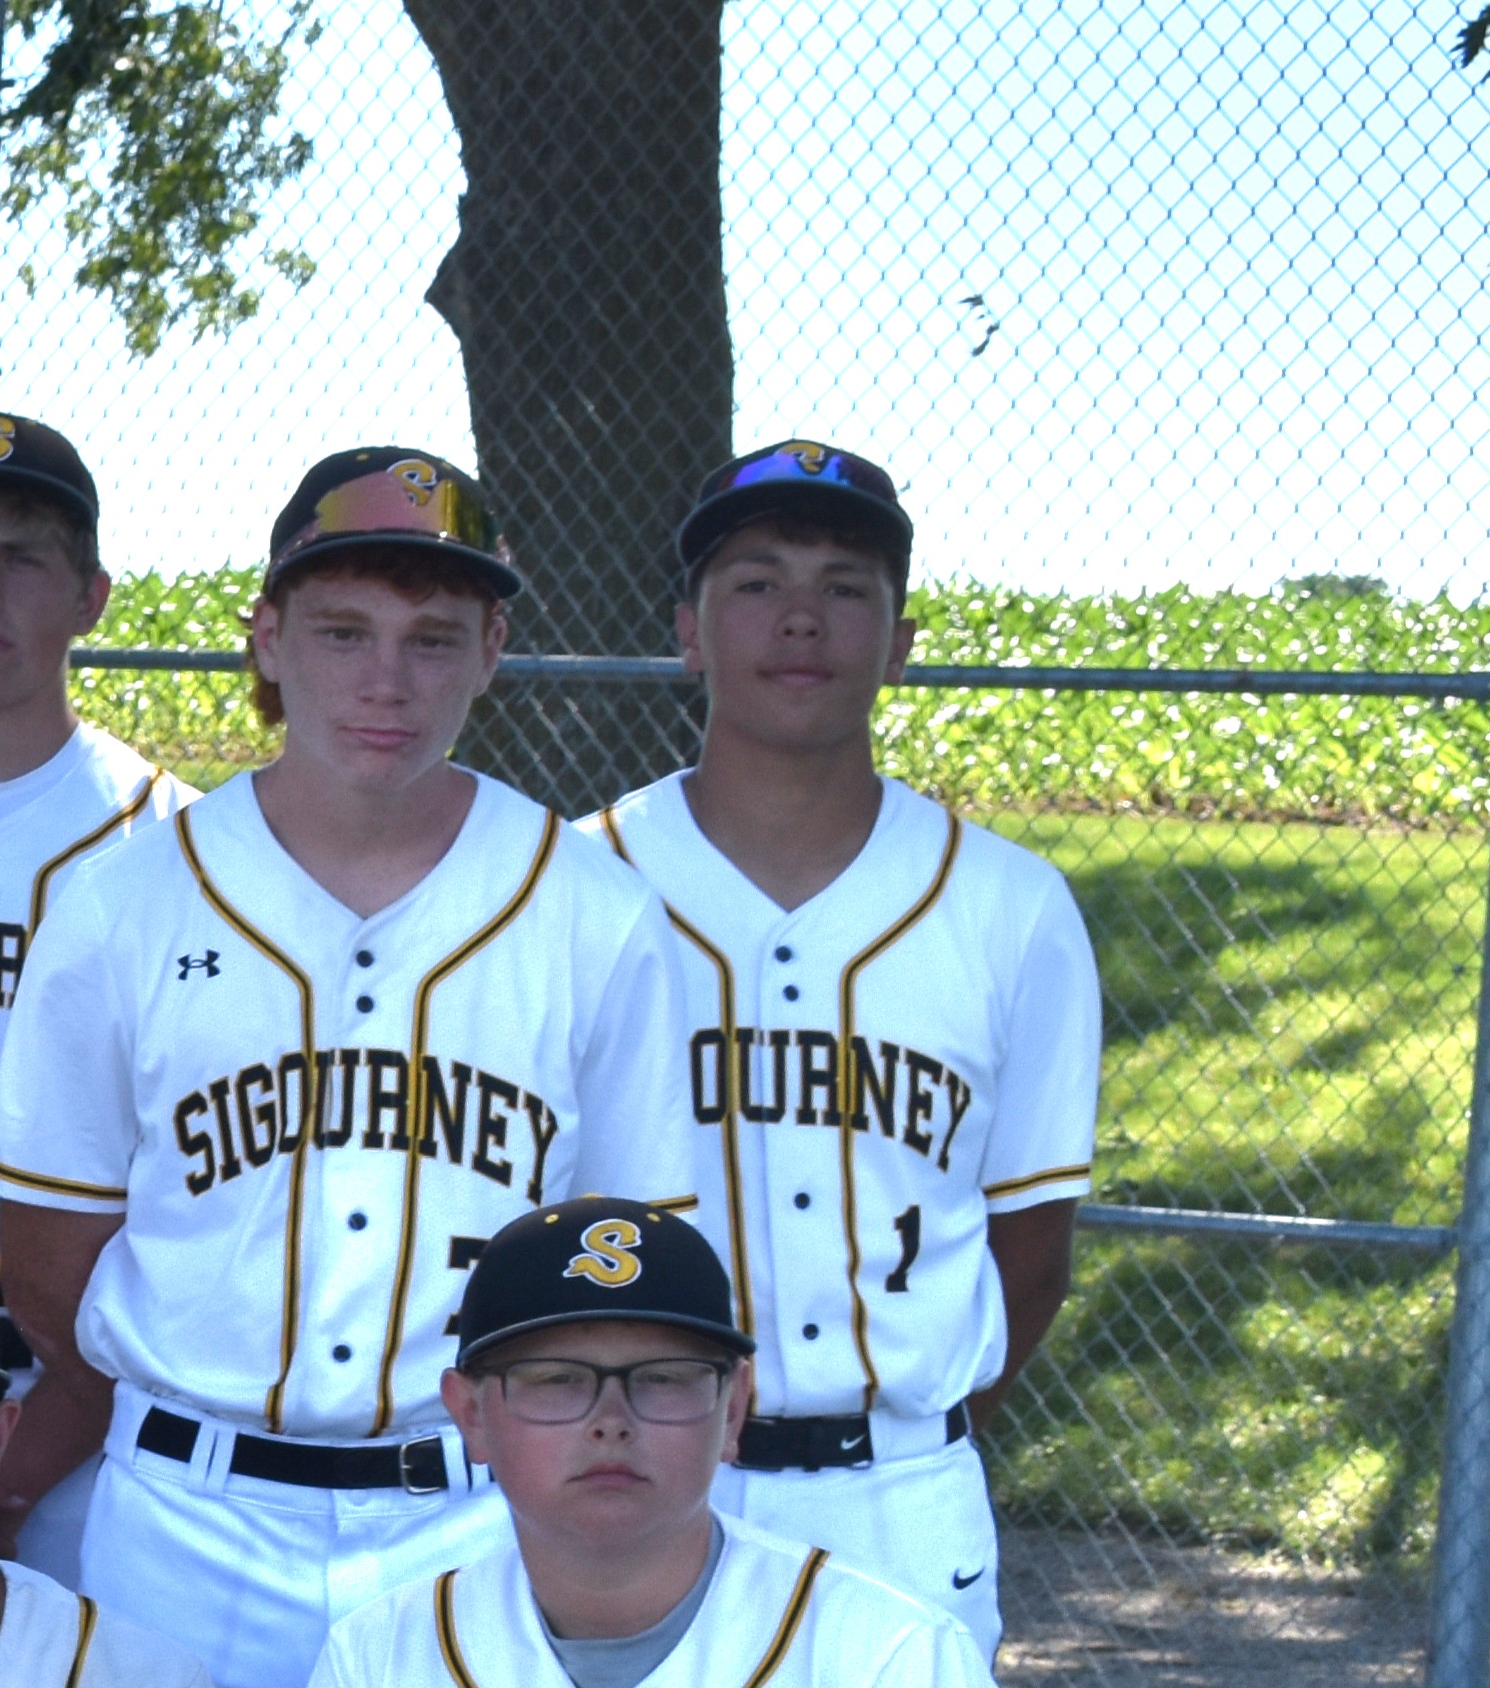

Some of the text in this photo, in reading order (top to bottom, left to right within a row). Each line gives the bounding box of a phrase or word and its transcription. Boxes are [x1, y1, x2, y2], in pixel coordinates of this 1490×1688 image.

[173, 1047, 559, 1208] SIGOURNEY
[689, 1027, 972, 1174] OURNEY
[561, 1216, 643, 1288] S
[885, 1203, 922, 1293] 1
